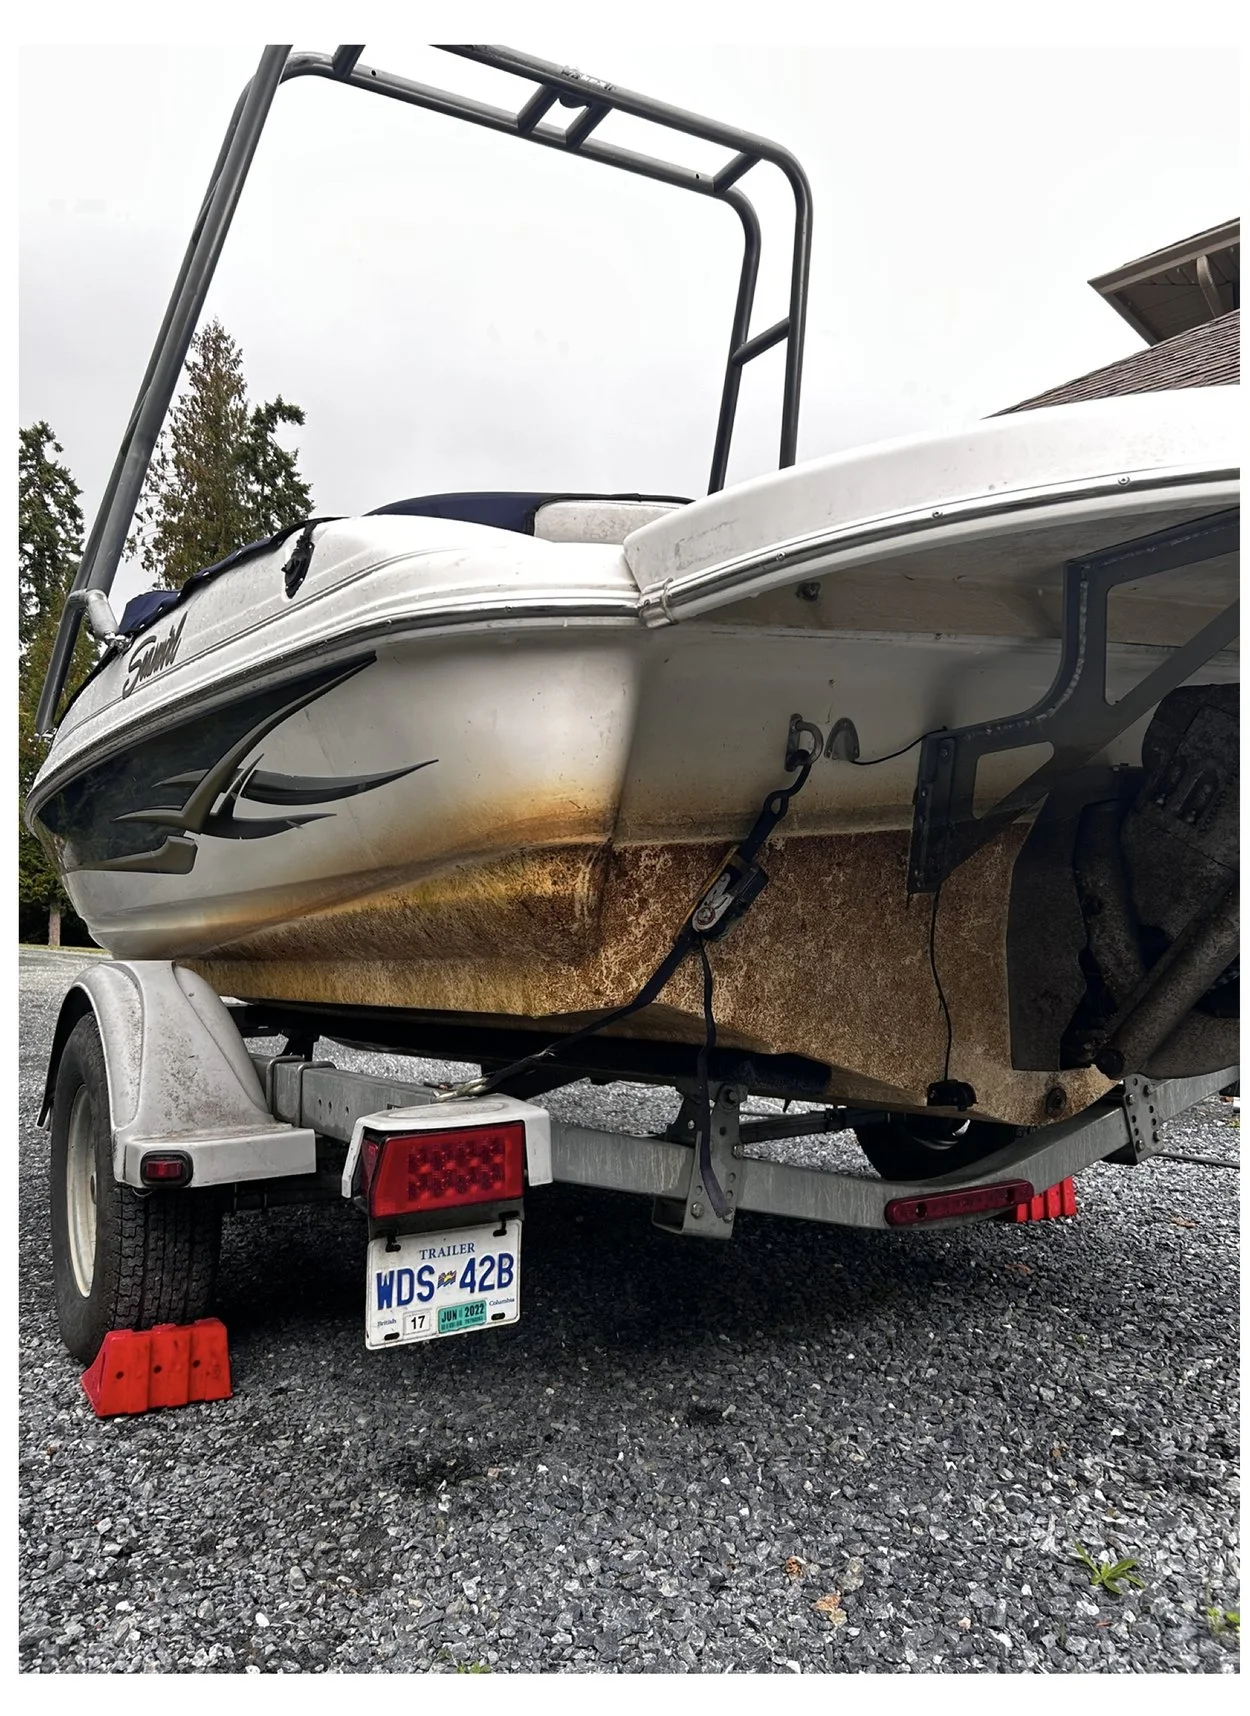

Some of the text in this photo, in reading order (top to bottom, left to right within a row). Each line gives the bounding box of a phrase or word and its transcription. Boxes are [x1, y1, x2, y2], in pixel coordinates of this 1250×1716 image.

[419, 1242, 475, 1260] TRAILER
[376, 1252, 515, 1310] WDS 42B
[489, 1297, 515, 1306] Columbia
[441, 1302, 485, 1323] JUN 2022
[377, 1317, 397, 1327] British
[411, 1315, 426, 1331] 17
